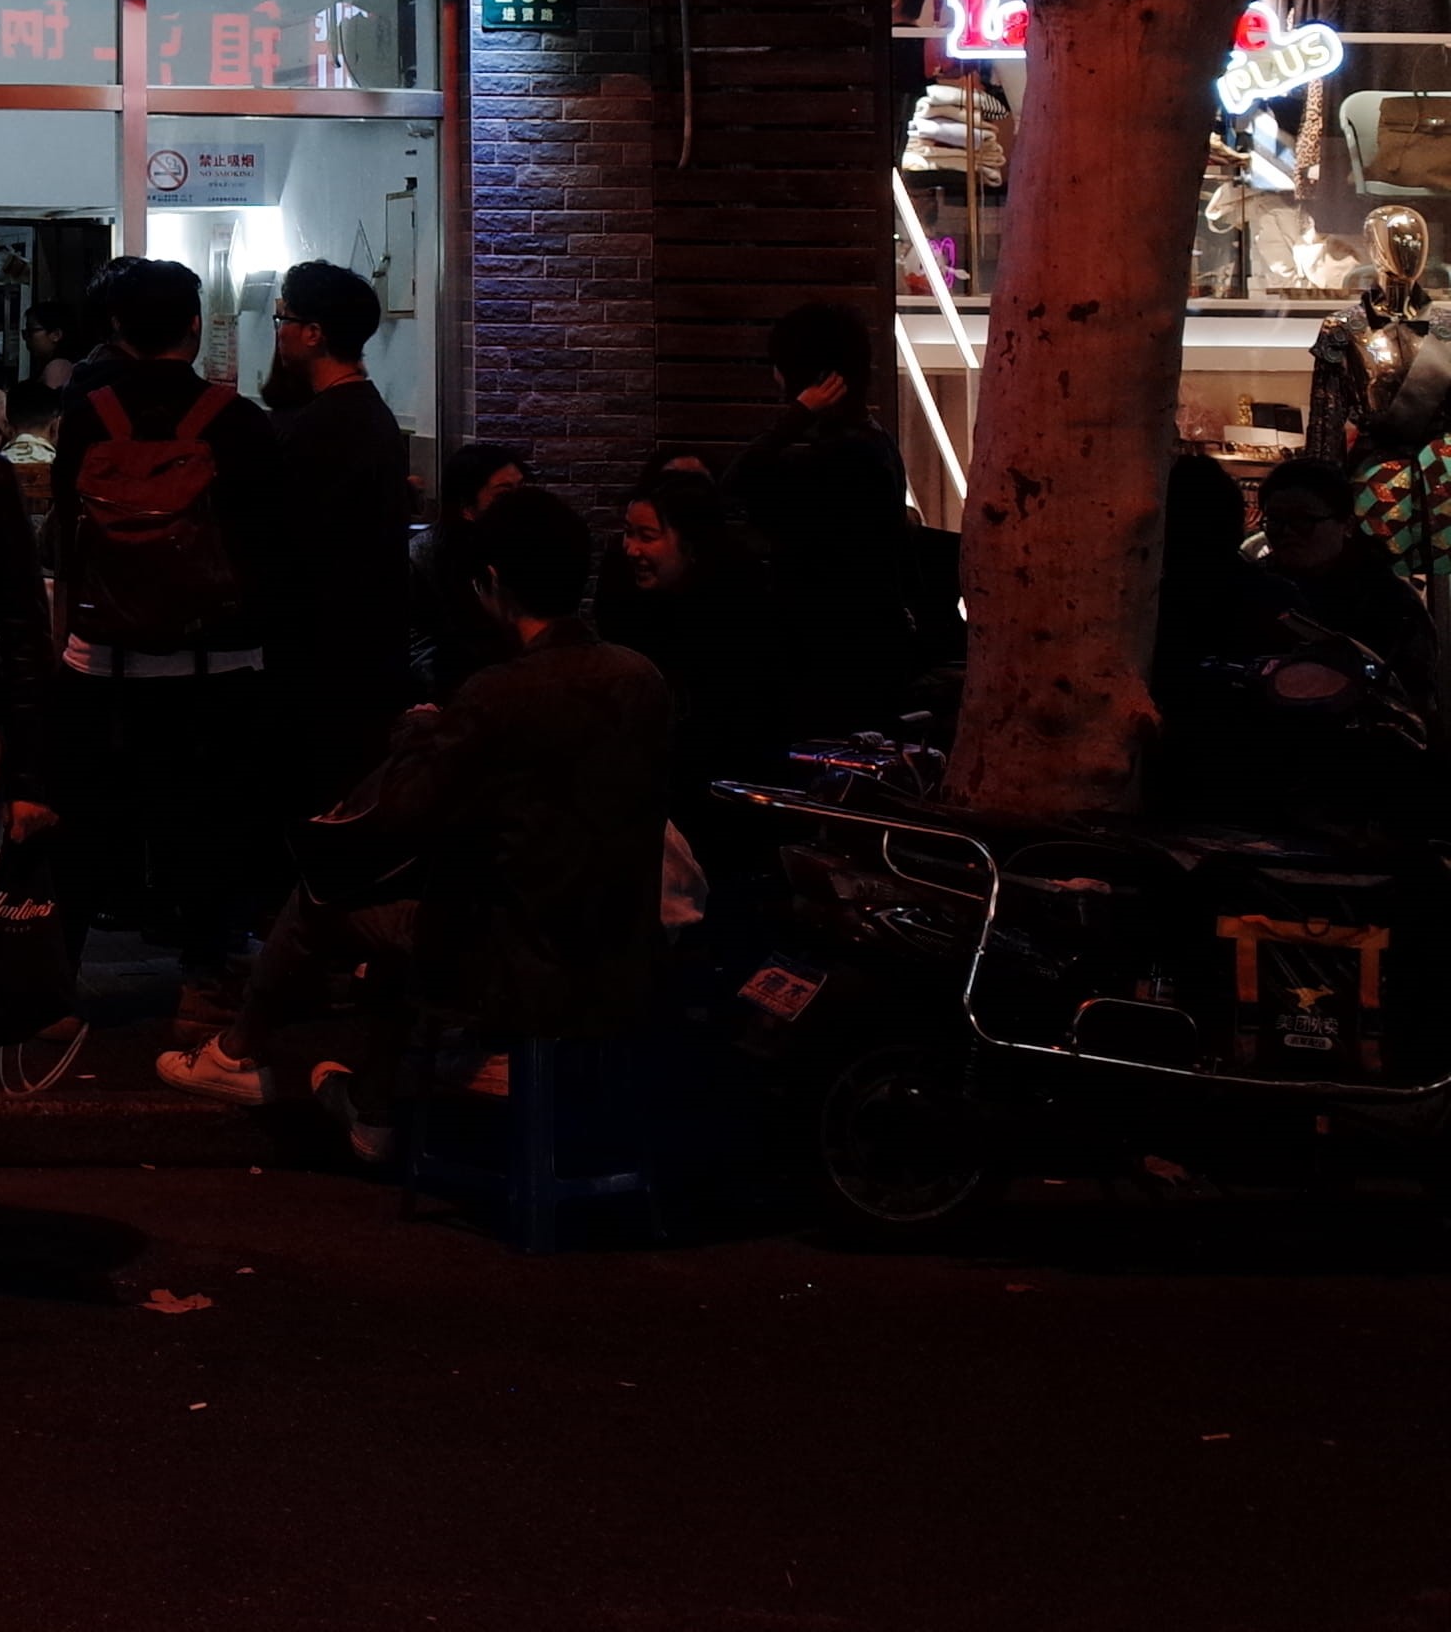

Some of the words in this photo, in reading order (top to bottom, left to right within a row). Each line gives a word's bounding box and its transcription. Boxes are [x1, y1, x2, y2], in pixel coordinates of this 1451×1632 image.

[1225, 38, 1330, 98] PLUS
[199, 154, 255, 168] 禁止吸烟
[1275, 1014, 1339, 1036] 美团外卖
